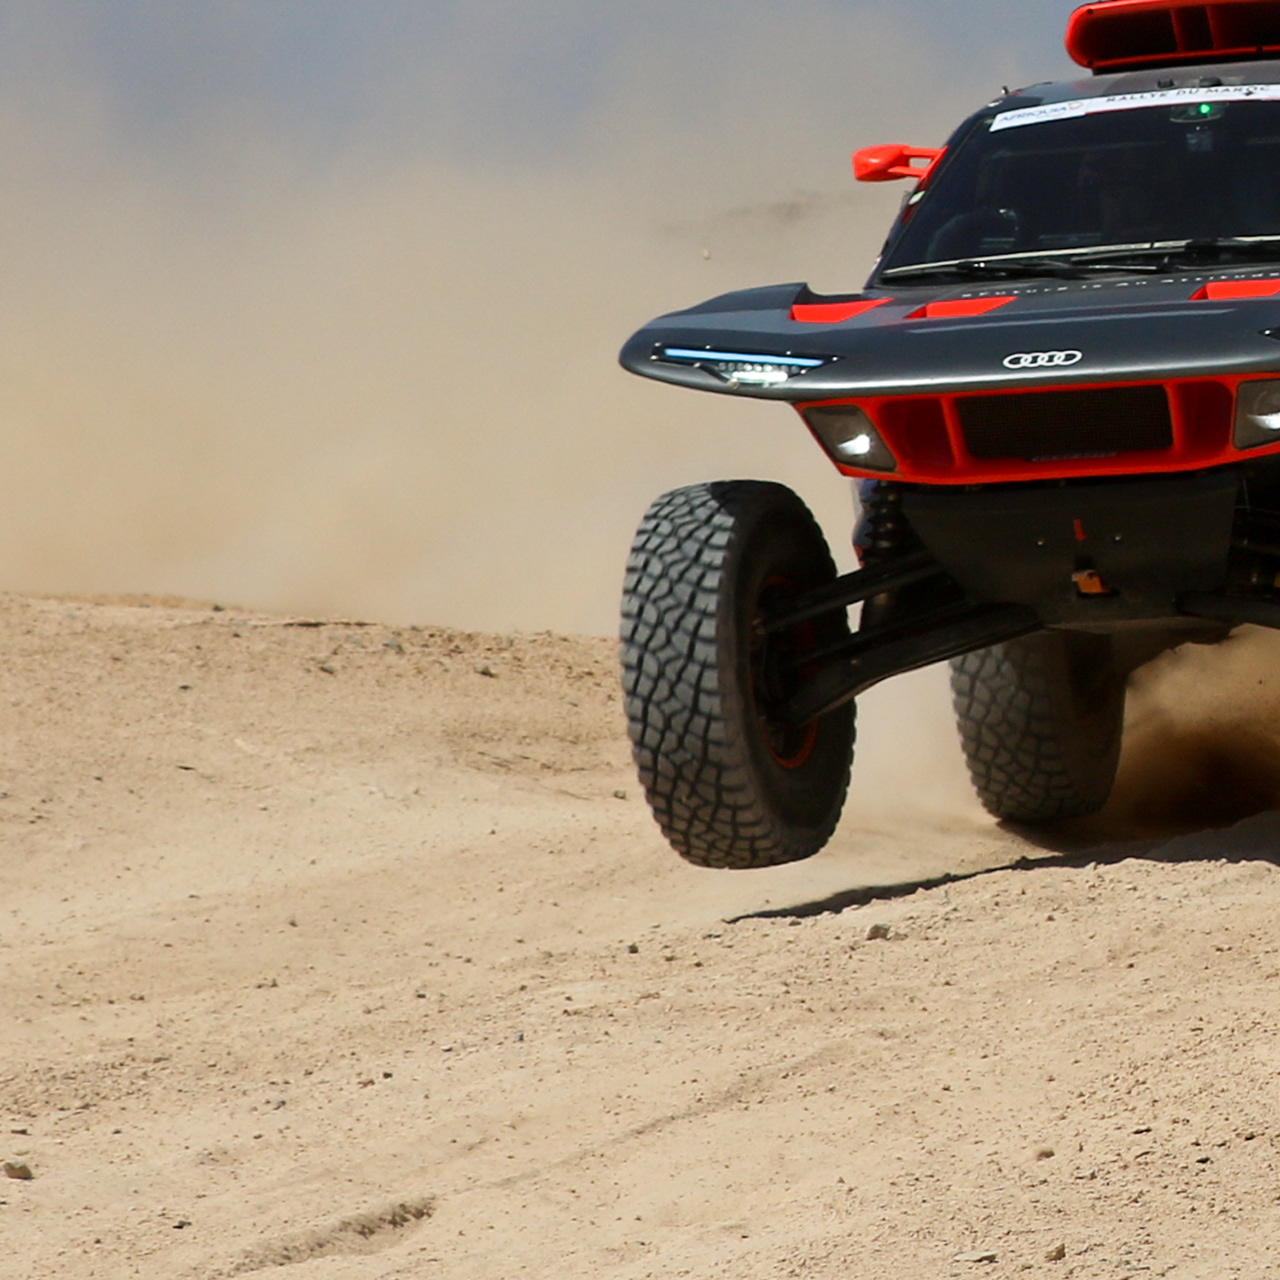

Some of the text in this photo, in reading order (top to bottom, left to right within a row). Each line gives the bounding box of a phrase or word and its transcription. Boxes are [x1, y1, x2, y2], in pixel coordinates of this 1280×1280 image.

[1106, 85, 1270, 102] RALLYE DU MAROC
